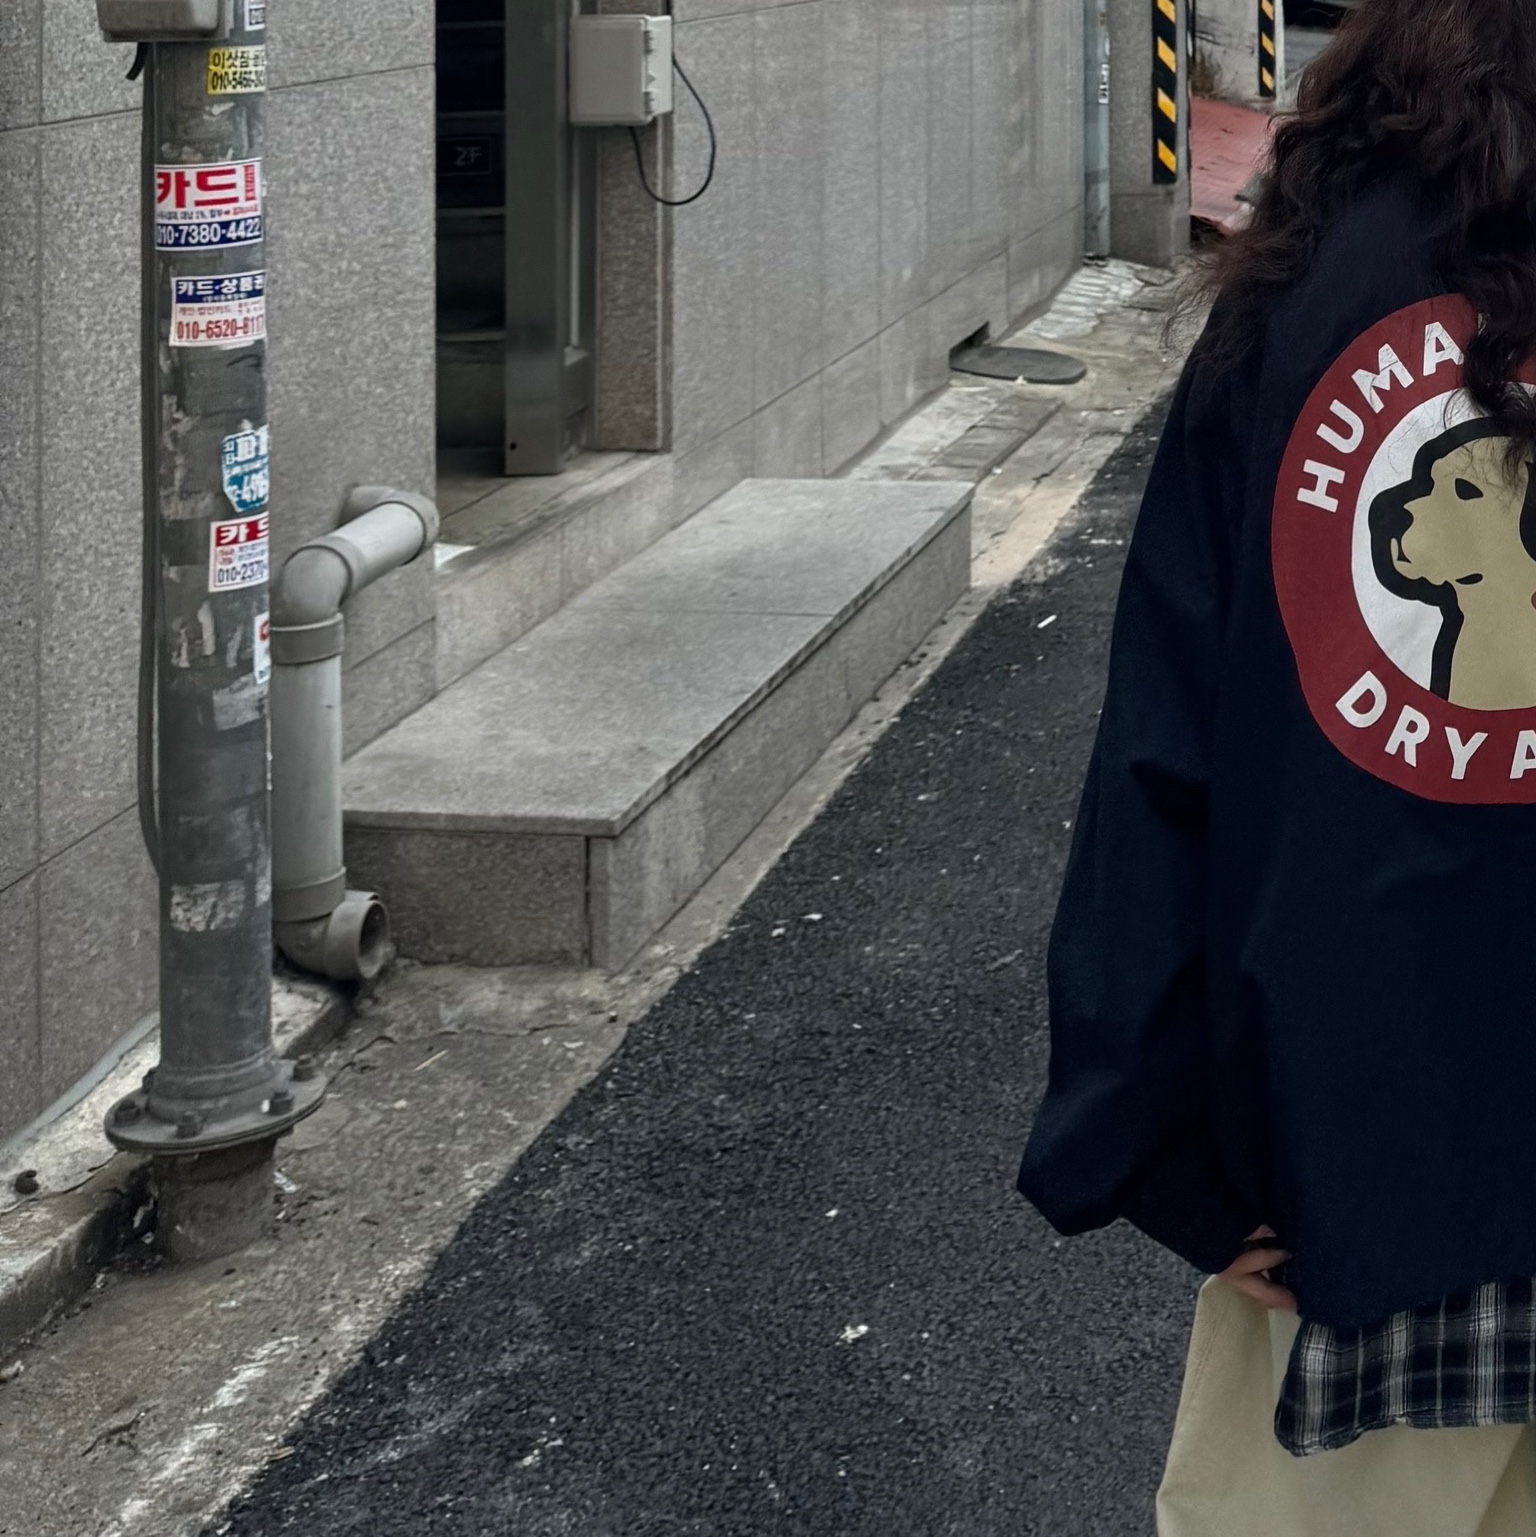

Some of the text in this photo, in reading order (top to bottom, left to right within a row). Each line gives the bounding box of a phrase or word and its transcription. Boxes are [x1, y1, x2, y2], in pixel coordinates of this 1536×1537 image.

[156, 167, 240, 210] 카드
[1296, 321, 1466, 513] HUMA
[1334, 670, 1489, 780] DRY
